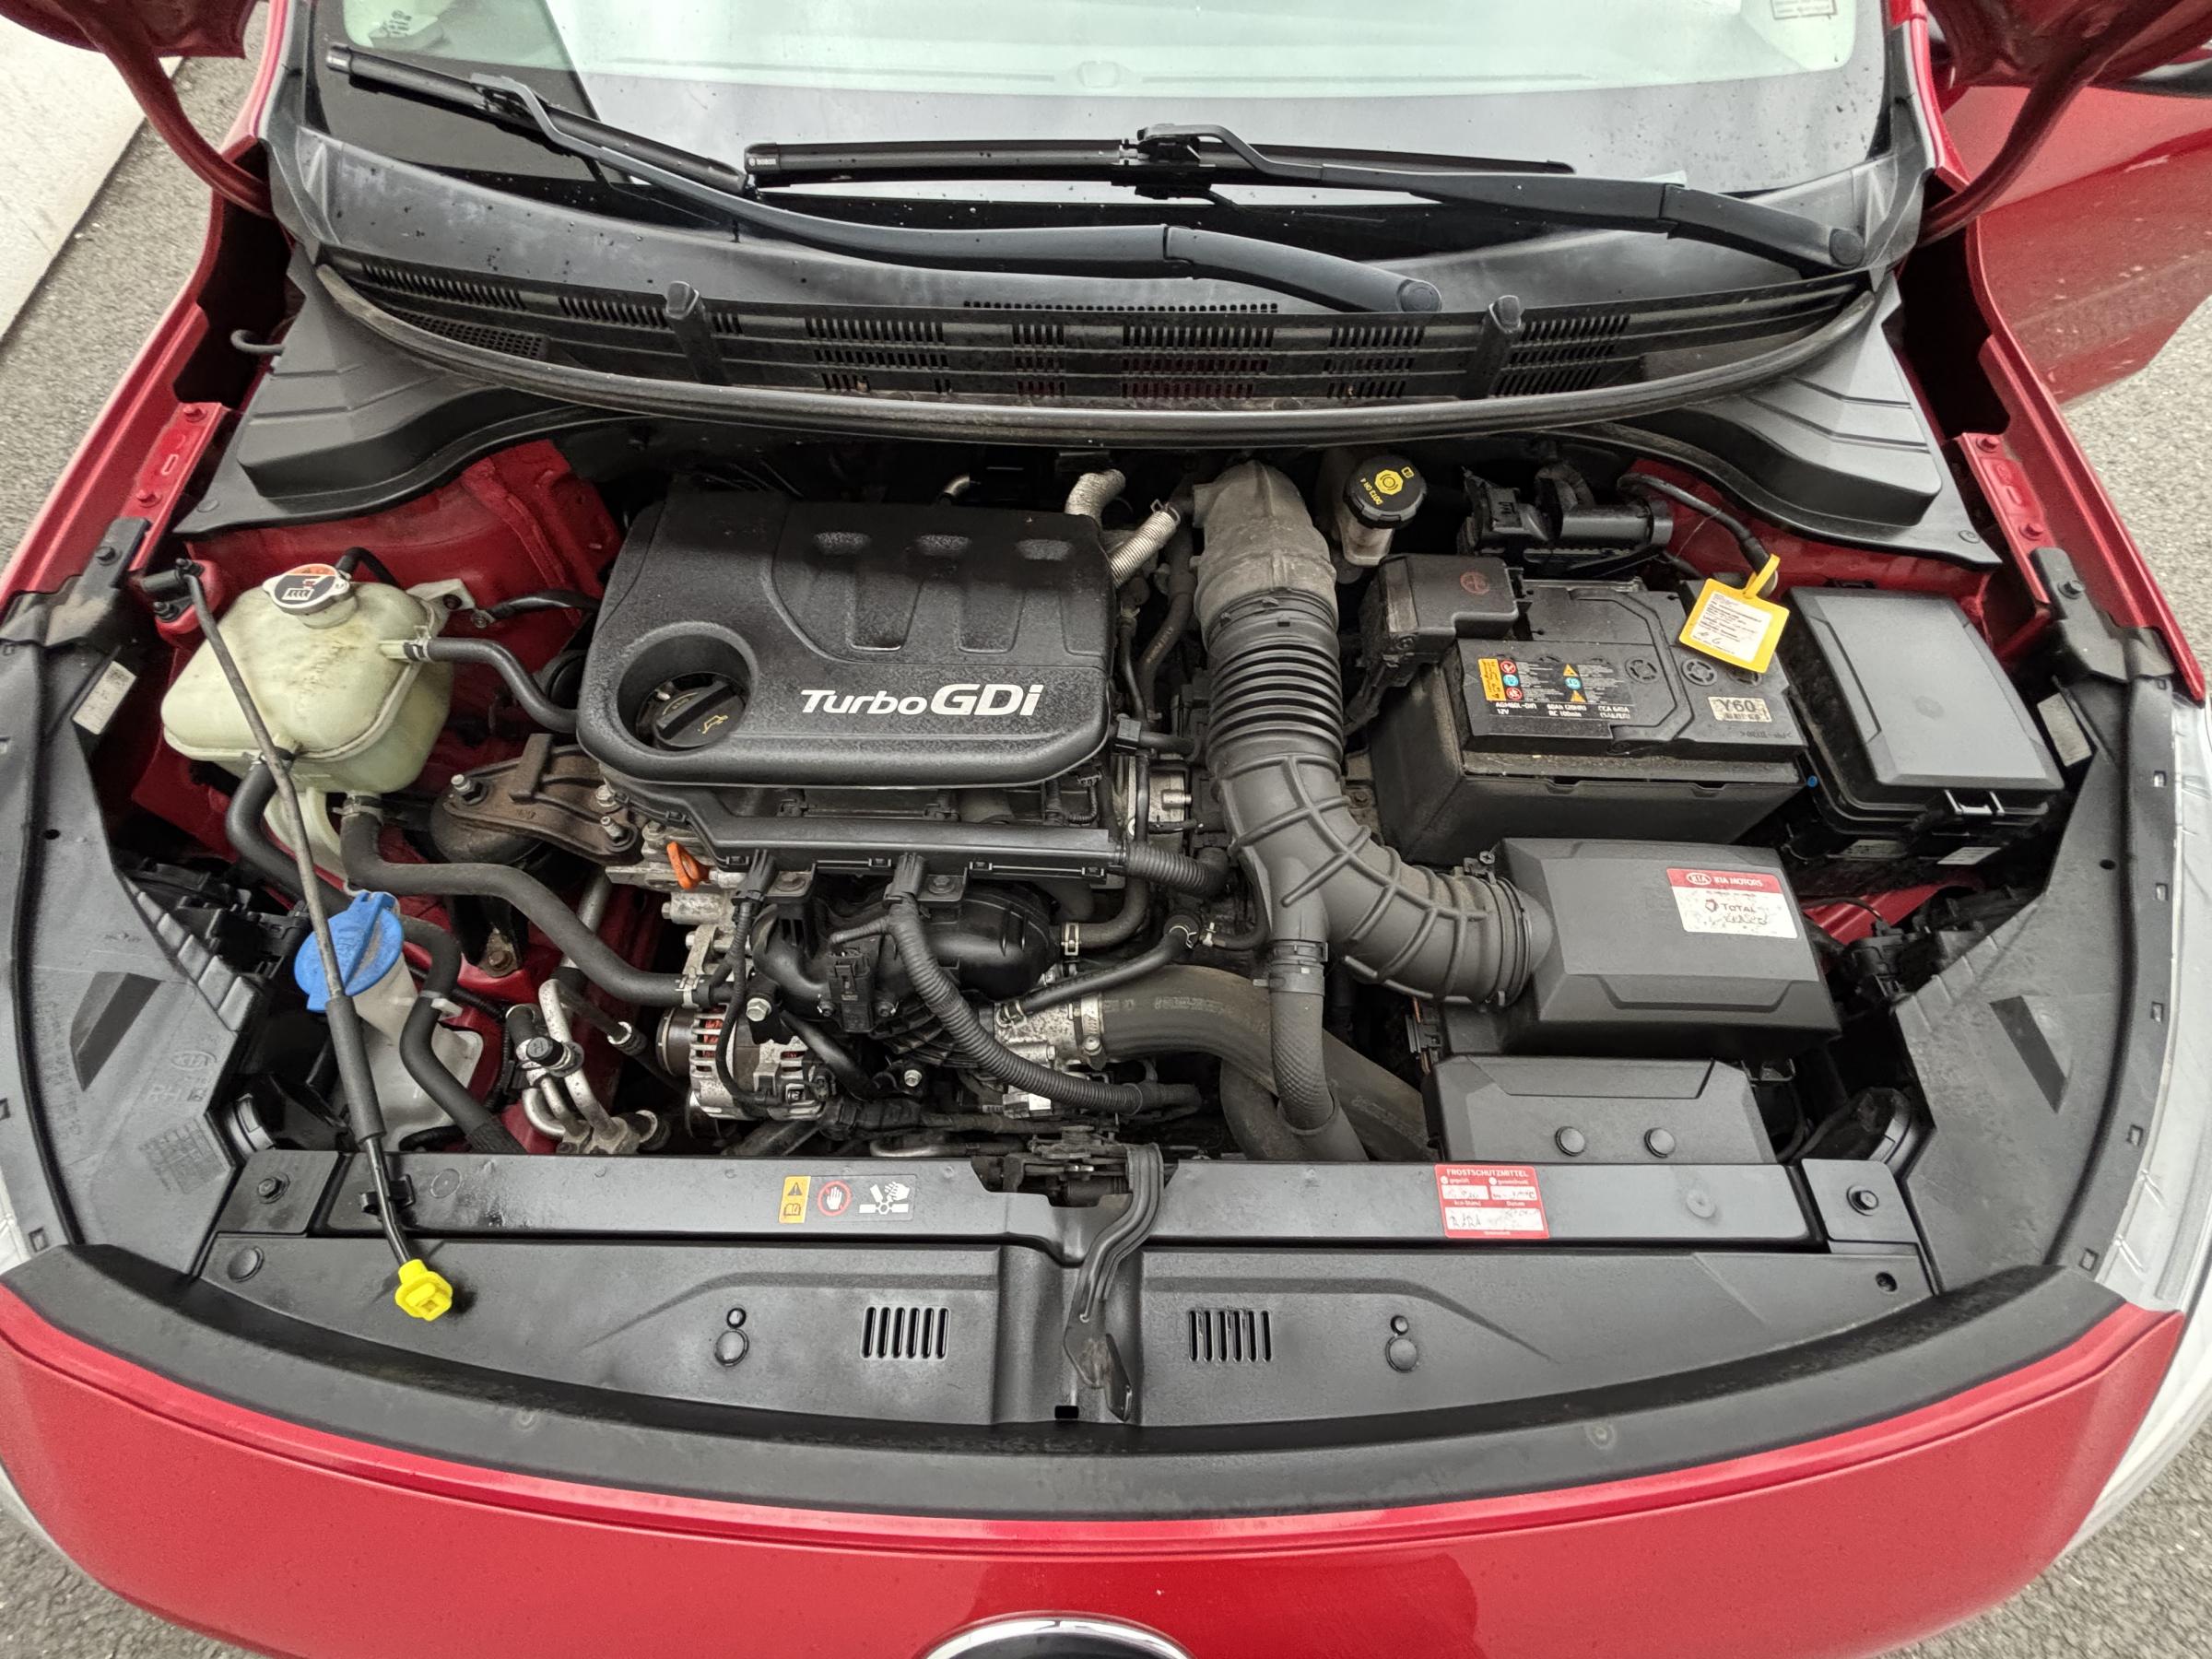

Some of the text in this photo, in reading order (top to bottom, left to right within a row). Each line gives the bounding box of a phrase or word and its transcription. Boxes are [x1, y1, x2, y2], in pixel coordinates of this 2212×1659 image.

[1716, 699, 1756, 712] Y60
[1730, 877, 1763, 886] MOTORS
[1446, 1168, 1529, 1177] FROSTSCHUTZMITTEL
